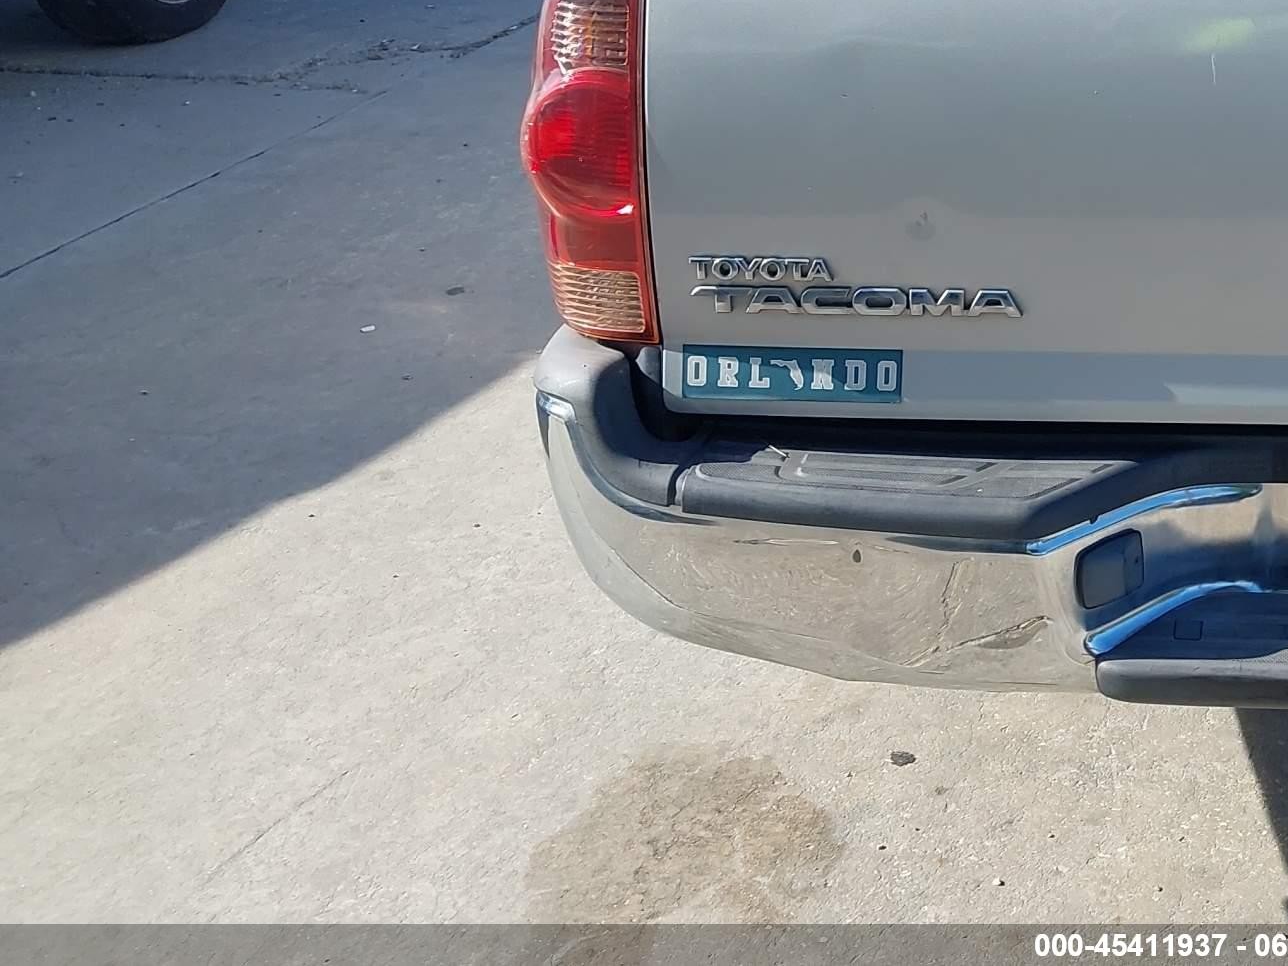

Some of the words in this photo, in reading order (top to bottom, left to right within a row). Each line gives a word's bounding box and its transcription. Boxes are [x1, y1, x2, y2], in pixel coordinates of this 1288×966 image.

[688, 256, 834, 282] TOYOTA
[689, 285, 1024, 318] TACOMA
[686, 355, 898, 392] ORLNDO
